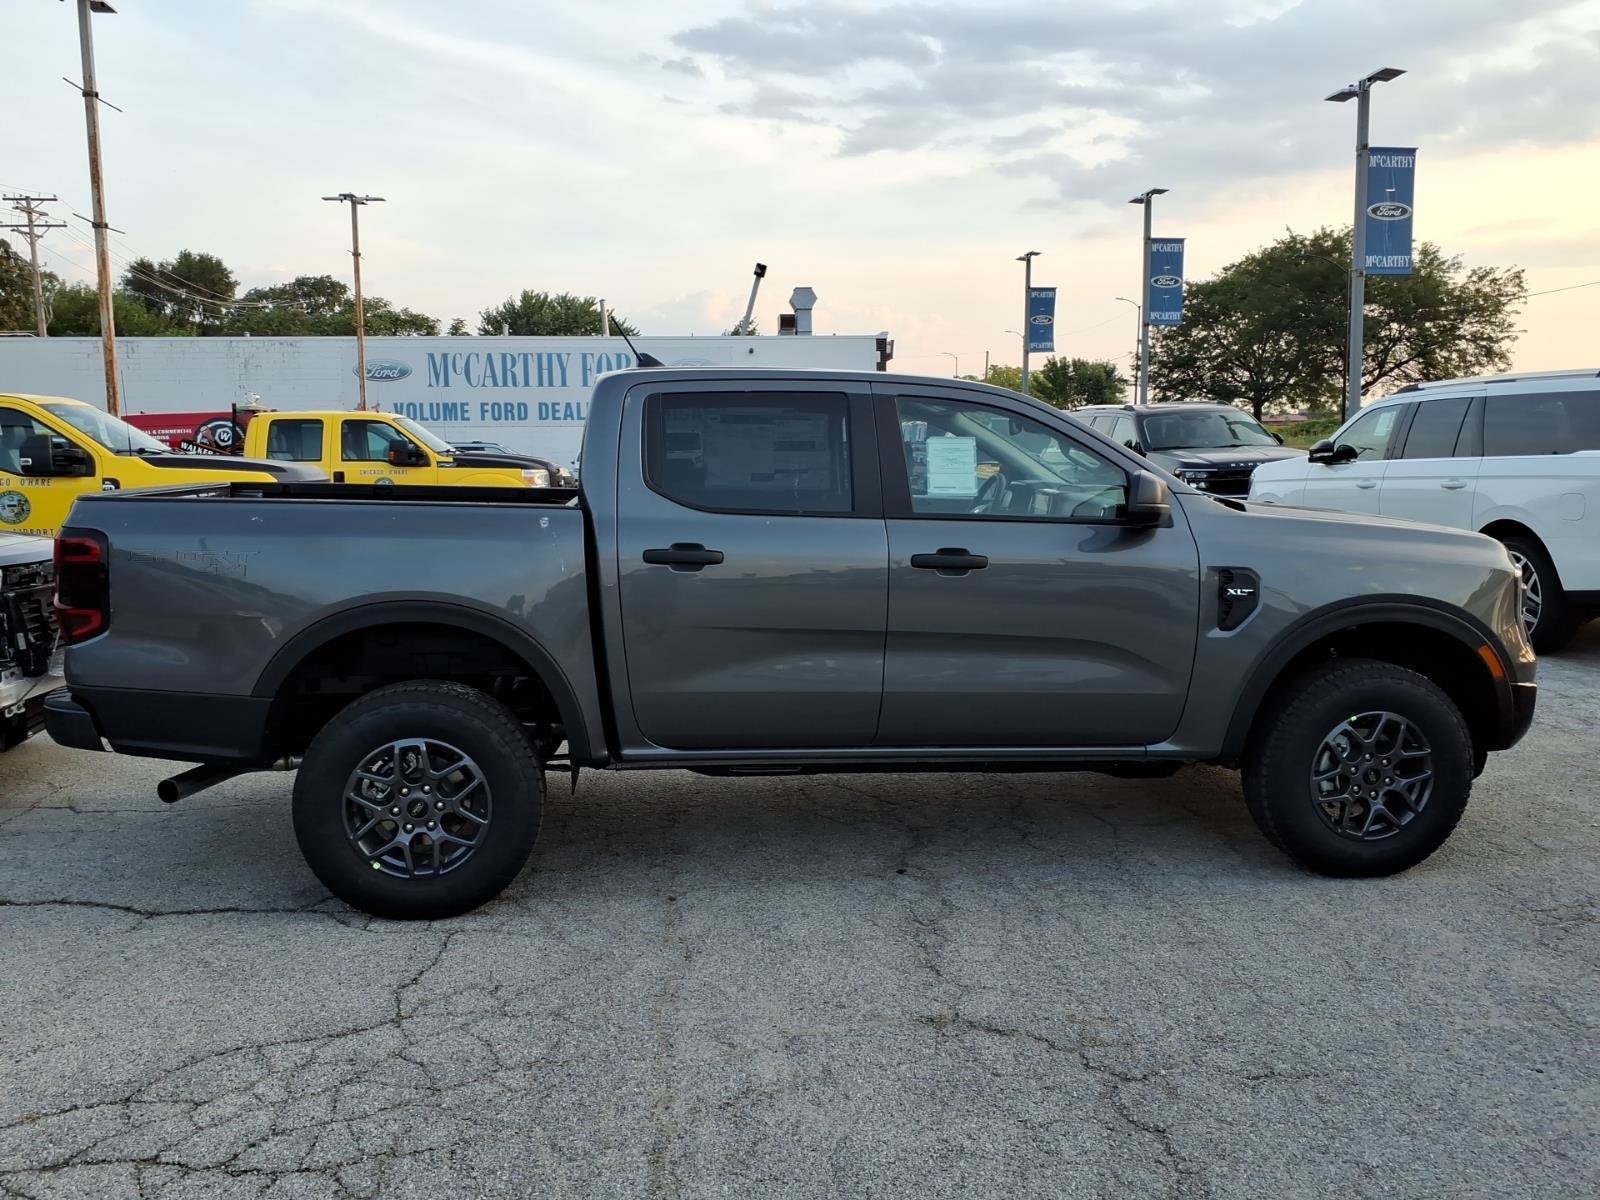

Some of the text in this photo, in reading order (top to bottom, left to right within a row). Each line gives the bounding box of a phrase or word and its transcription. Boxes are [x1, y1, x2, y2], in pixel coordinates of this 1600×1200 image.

[1377, 205, 1402, 216] Ford
[1157, 277, 1175, 285] Ford
[366, 363, 400, 378] Ford
[393, 402, 589, 422] VOLUME FORD DEAL
[1227, 588, 1254, 596] XLT
